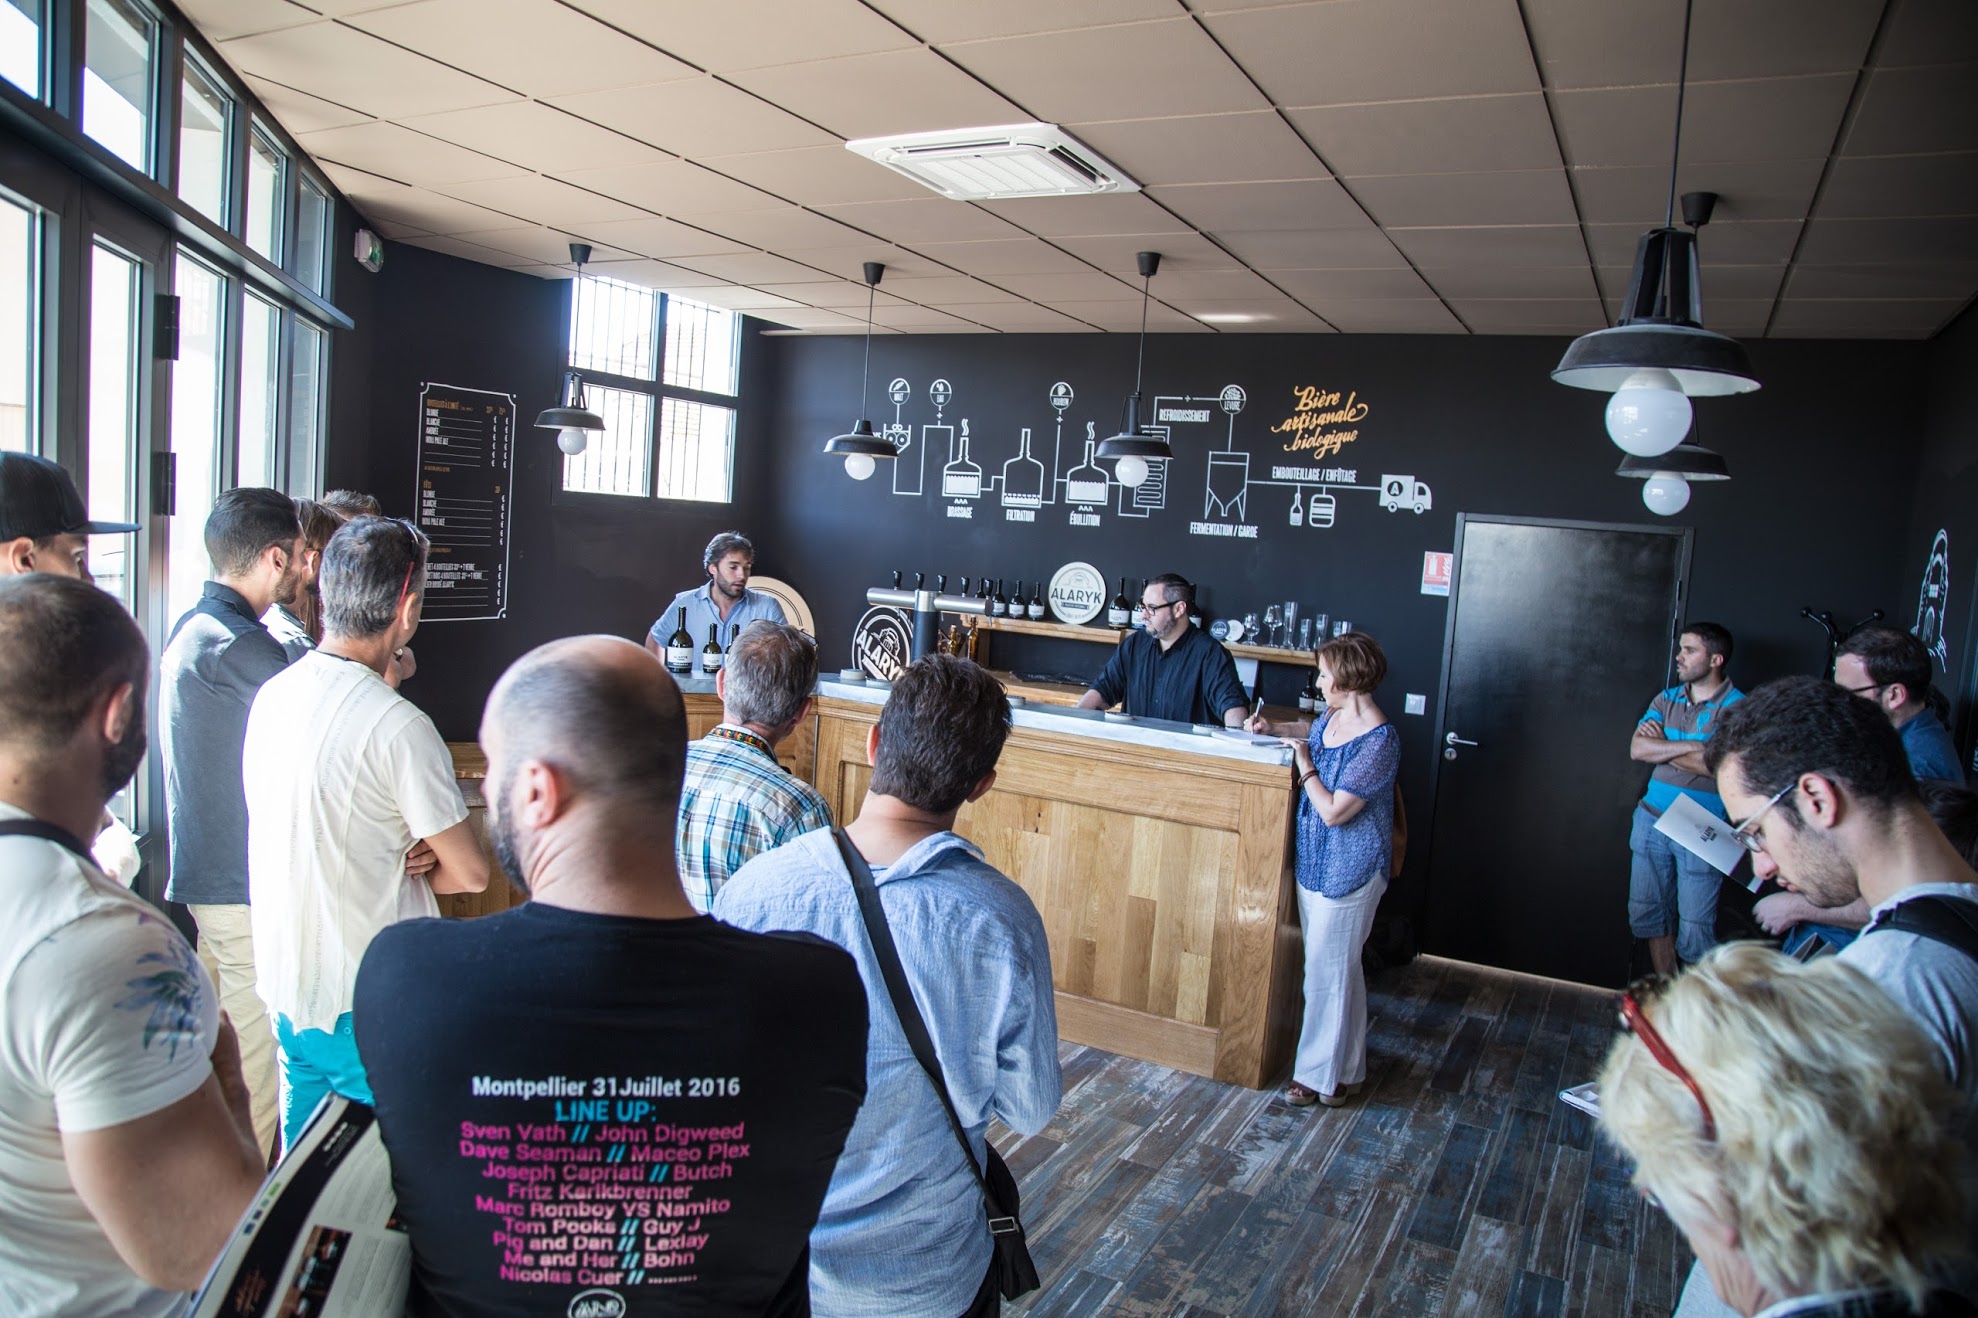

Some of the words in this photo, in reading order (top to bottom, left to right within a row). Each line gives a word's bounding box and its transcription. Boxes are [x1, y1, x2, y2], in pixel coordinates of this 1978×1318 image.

[1294, 385, 1341, 411] Bière
[1159, 408, 1210, 422] REFROIDISSEMENT
[1270, 391, 1369, 433] artisanale
[1283, 427, 1358, 460] biologique
[1272, 466, 1320, 481] EMBOUTEILLAGE
[1325, 467, 1357, 483] ENFÛTAGE
[1390, 482, 1400, 495] A
[947, 506, 973, 518] BRASSAGE
[1006, 509, 1036, 522] FILTRATION
[1069, 511, 1101, 527] ÉBULLITION
[1190, 522, 1233, 537] FERMENTATION
[1238, 525, 1258, 539] GARDE
[1051, 587, 1102, 604] ALARYK
[472, 1076, 587, 1101] Montpellier
[688, 1077, 741, 1097] 2016
[555, 1100, 609, 1122] LINE
[616, 1100, 656, 1122] UP:
[460, 1121, 511, 1141] Sven
[516, 1123, 566, 1141] Vath
[594, 1124, 648, 1142] John
[654, 1121, 745, 1146] Digweed
[460, 1140, 510, 1160] Dave
[516, 1143, 602, 1162] Seaman
[631, 1145, 701, 1162] Maceo
[708, 1142, 750, 1160] Plex
[482, 1161, 556, 1183] Joseph
[562, 1163, 645, 1184] Capriati
[673, 1161, 733, 1181] Butch
[508, 1182, 554, 1200] Fritz
[475, 1195, 525, 1217] Marc
[530, 1202, 616, 1220] Romboy
[622, 1201, 651, 1217] VS
[656, 1197, 731, 1217] Namito
[502, 1216, 546, 1234] Tom
[552, 1218, 617, 1234] Pooks
[643, 1218, 684, 1237] Guy
[493, 1231, 524, 1252] Pig
[529, 1235, 568, 1251] and
[573, 1235, 614, 1251] Dan
[645, 1233, 710, 1251] Lexlay
[504, 1249, 535, 1267] Me
[539, 1251, 578, 1267] and
[583, 1252, 619, 1268] Her
[643, 1251, 695, 1268] Bohn
[500, 1264, 572, 1284] Nicolas
[578, 1269, 624, 1285] Cuer
